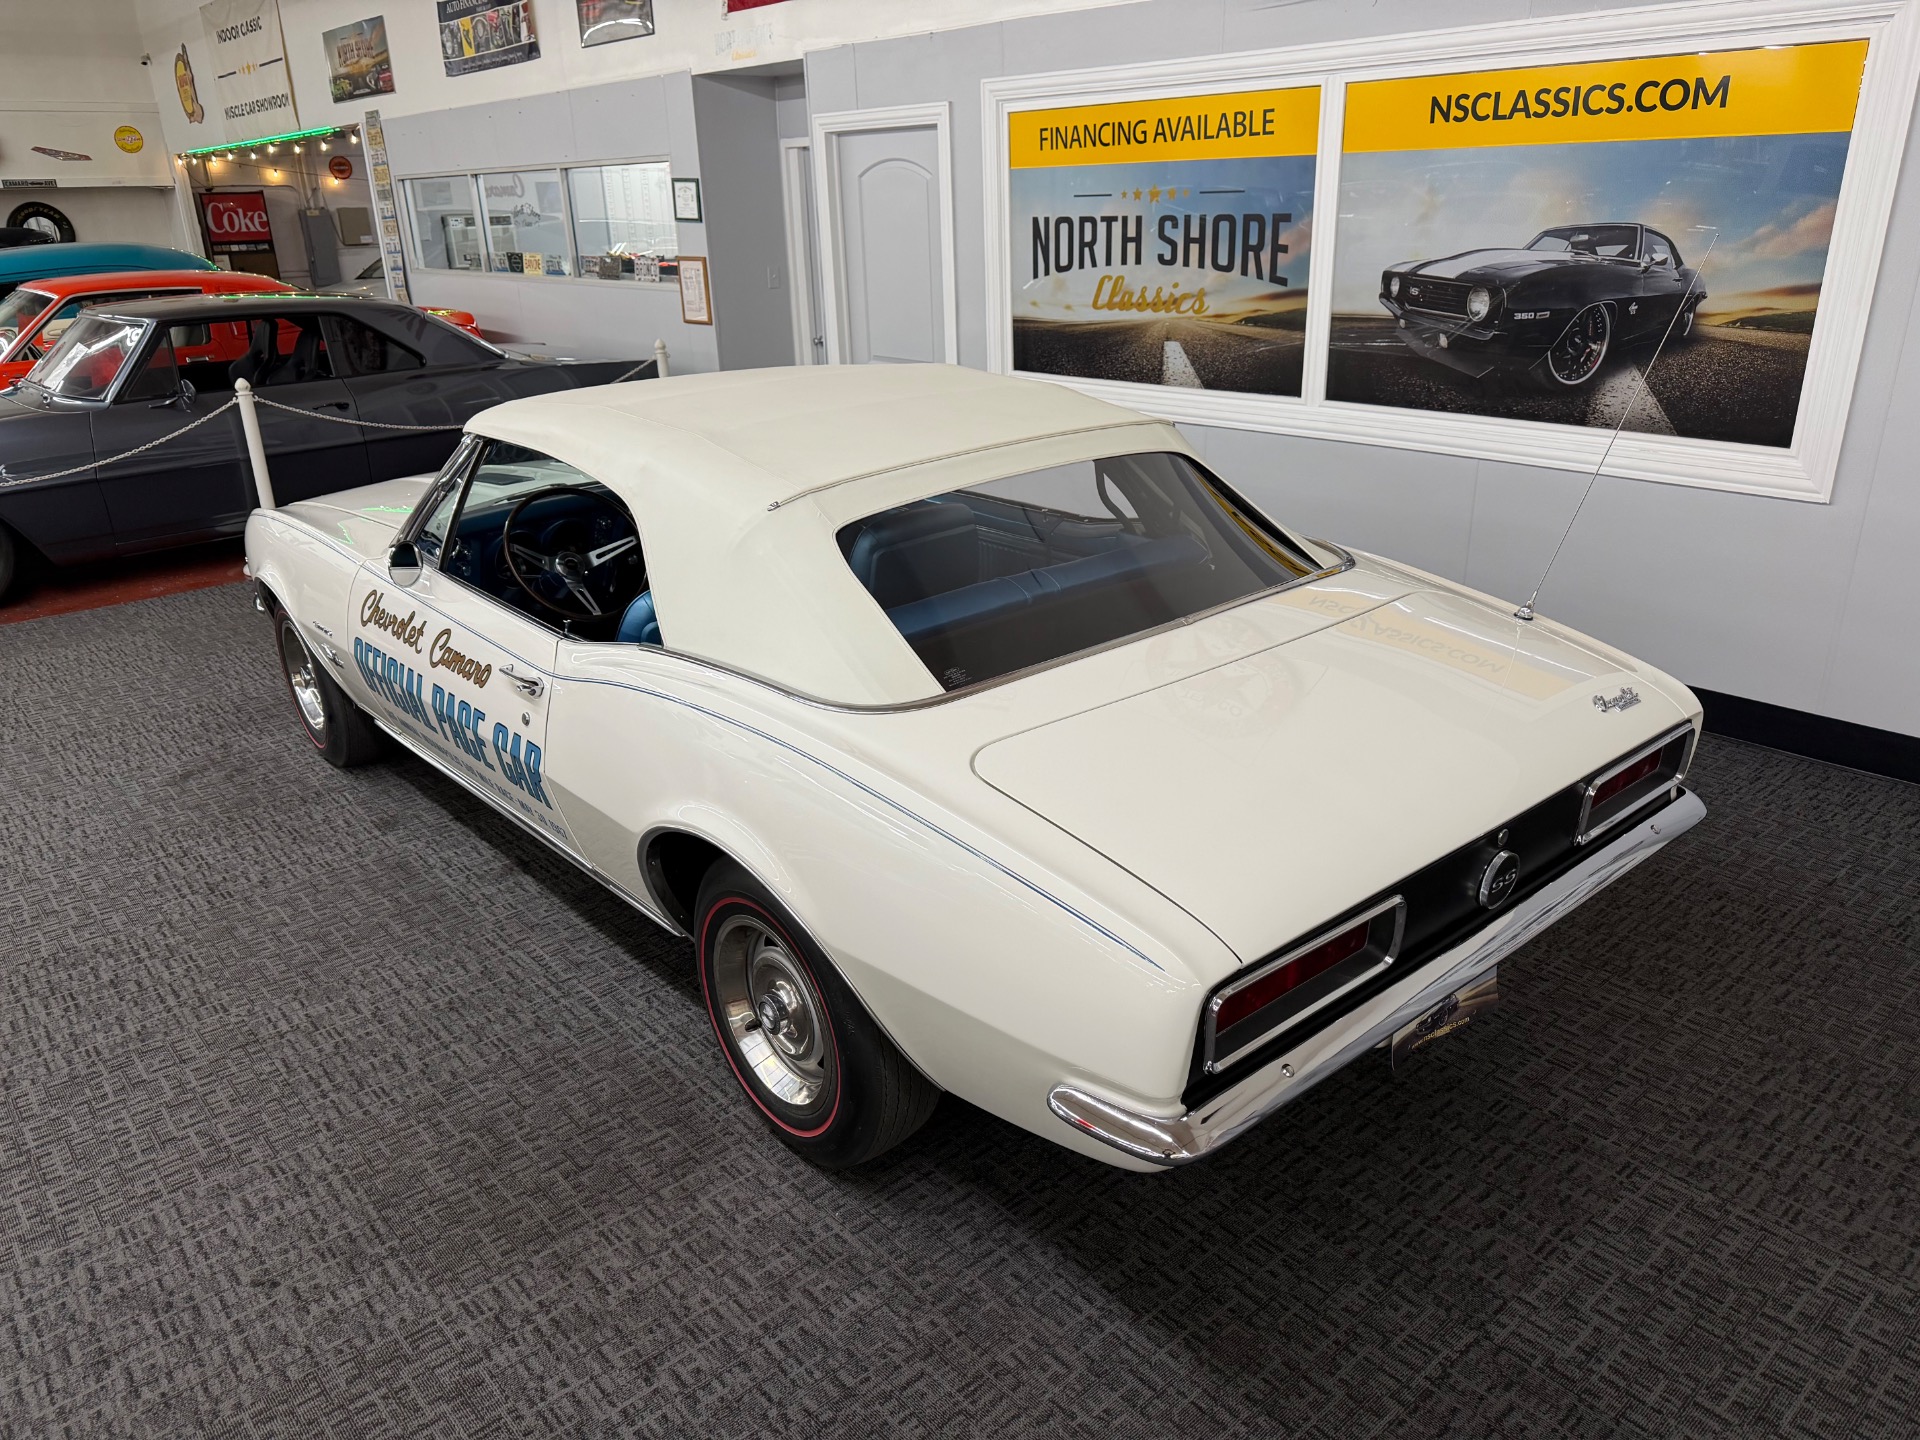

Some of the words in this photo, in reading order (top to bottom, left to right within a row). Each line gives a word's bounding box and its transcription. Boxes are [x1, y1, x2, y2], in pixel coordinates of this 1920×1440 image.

[216, 25, 240, 44] INDOOR
[240, 15, 262, 36] CLASSIC
[224, 103, 245, 120] MUSCLE
[245, 100, 257, 116] CAR
[256, 92, 290, 113] SHOWROOM
[1429, 75, 1731, 124] NSCLASSICS.COM
[1039, 119, 1148, 151] FINANCING
[1152, 107, 1276, 144] AVAILABLE
[5, 180, 29, 188] CAMARO
[206, 202, 269, 234] Coke
[1032, 215, 1143, 280] NORTH
[1157, 213, 1293, 287] SHORE
[1092, 274, 1211, 315] Classics
[1514, 311, 1535, 320] 350
[360, 589, 428, 655] Chevrolet
[429, 628, 493, 689] Camaro
[353, 636, 439, 735] OFFICIAL
[431, 682, 497, 773] PACE
[492, 721, 554, 811] CAR
[1492, 868, 1517, 894] SS
[1411, 1016, 1470, 1050] www.nsclassics.com
